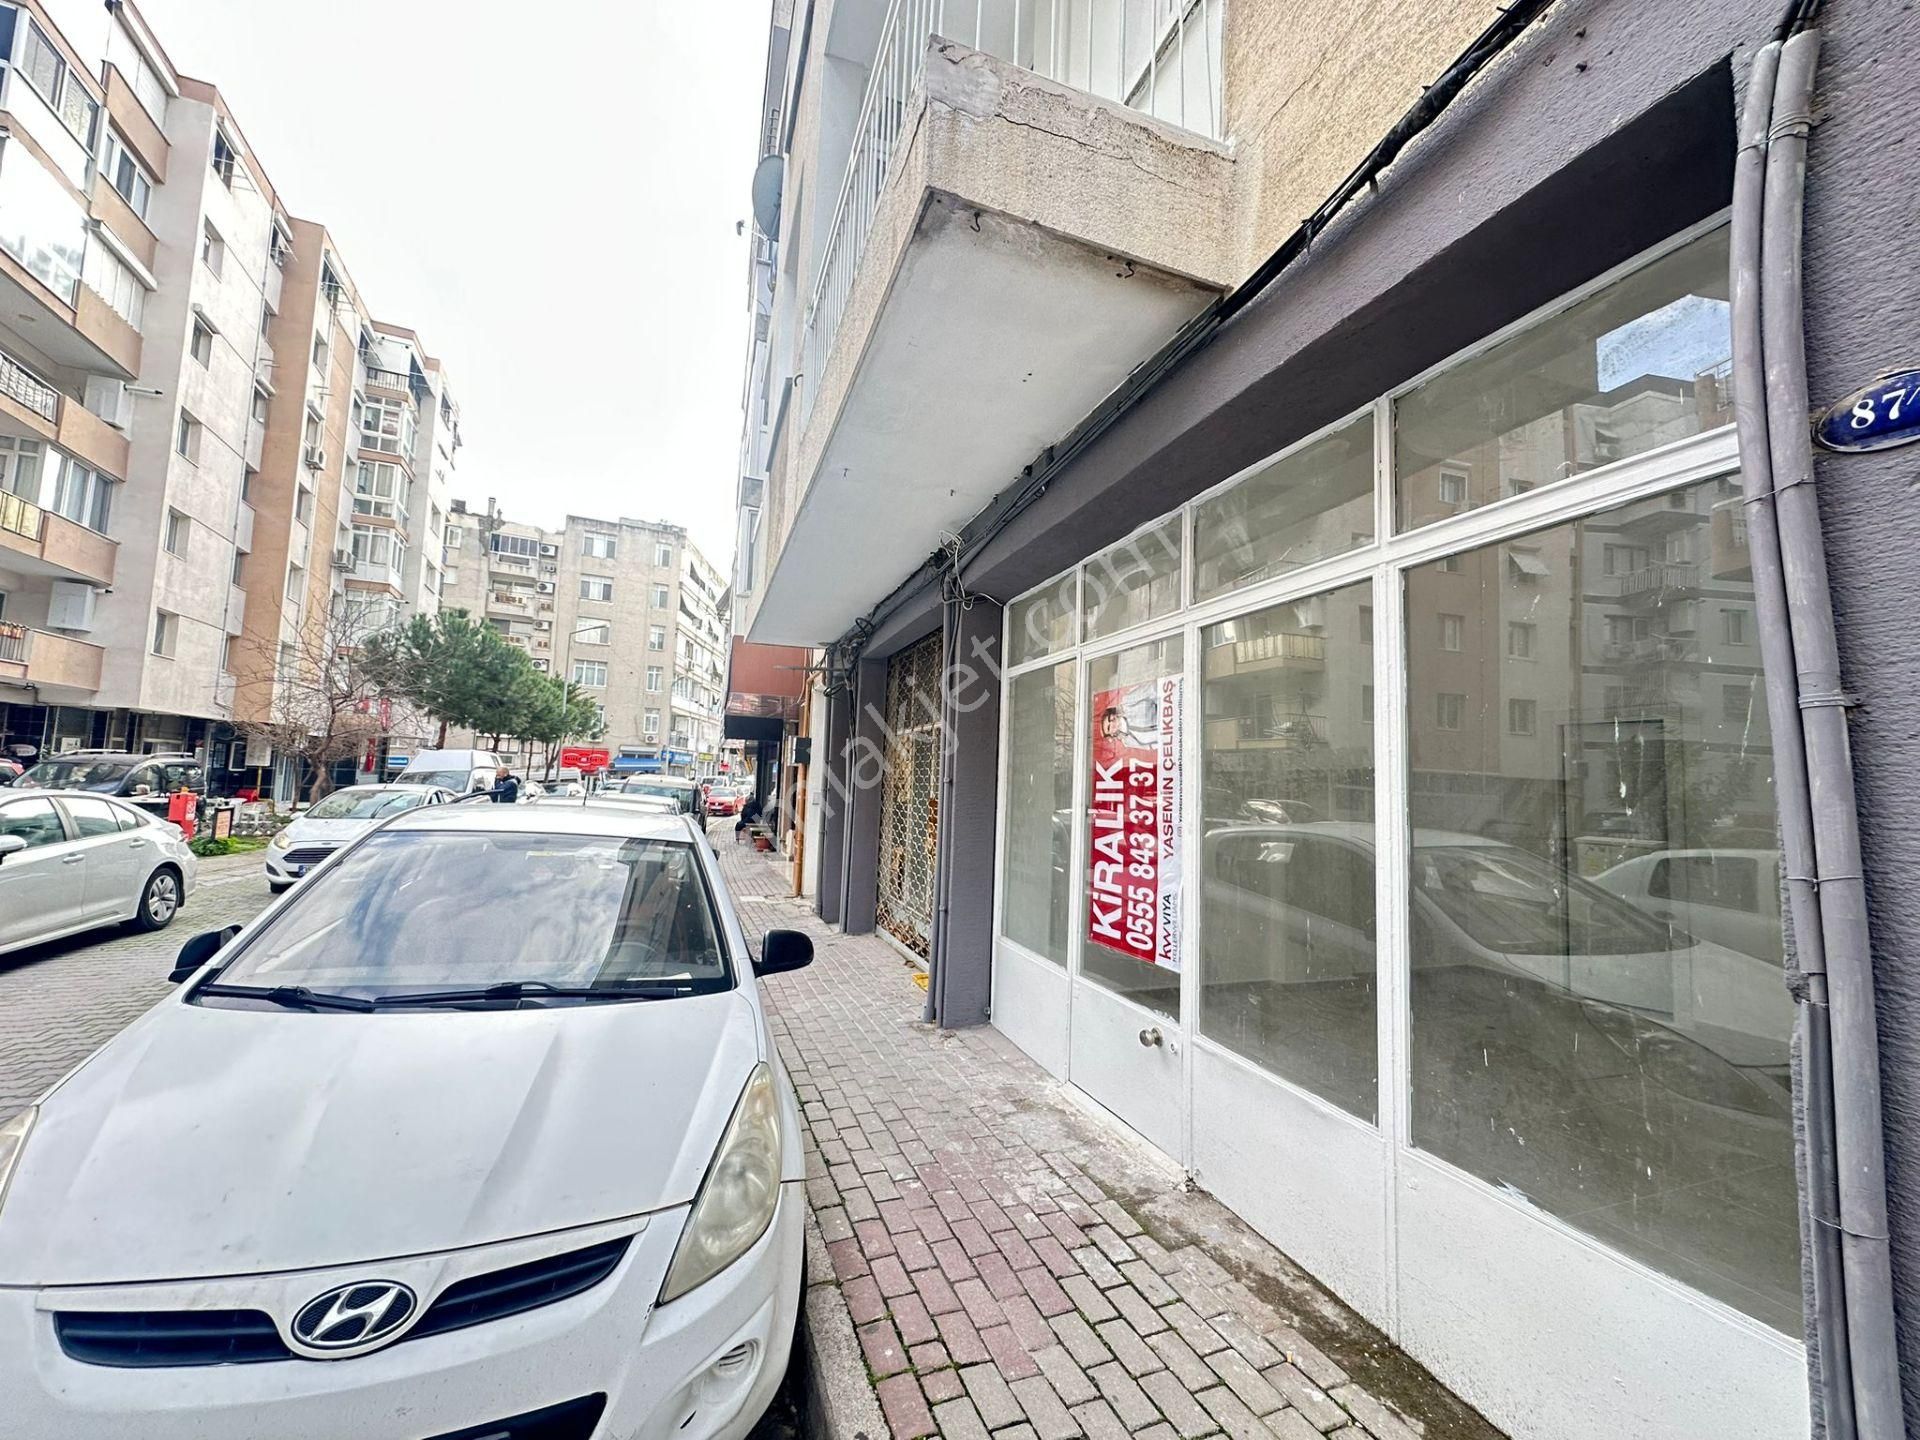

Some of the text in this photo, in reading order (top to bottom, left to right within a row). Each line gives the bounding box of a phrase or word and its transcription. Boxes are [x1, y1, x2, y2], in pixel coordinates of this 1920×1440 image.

[1125, 758, 1156, 951] 0555 843 37 37
[1160, 679, 1176, 860] YASEMİN ÇELİKBAŞ
[1162, 893, 1172, 926] VIYA
